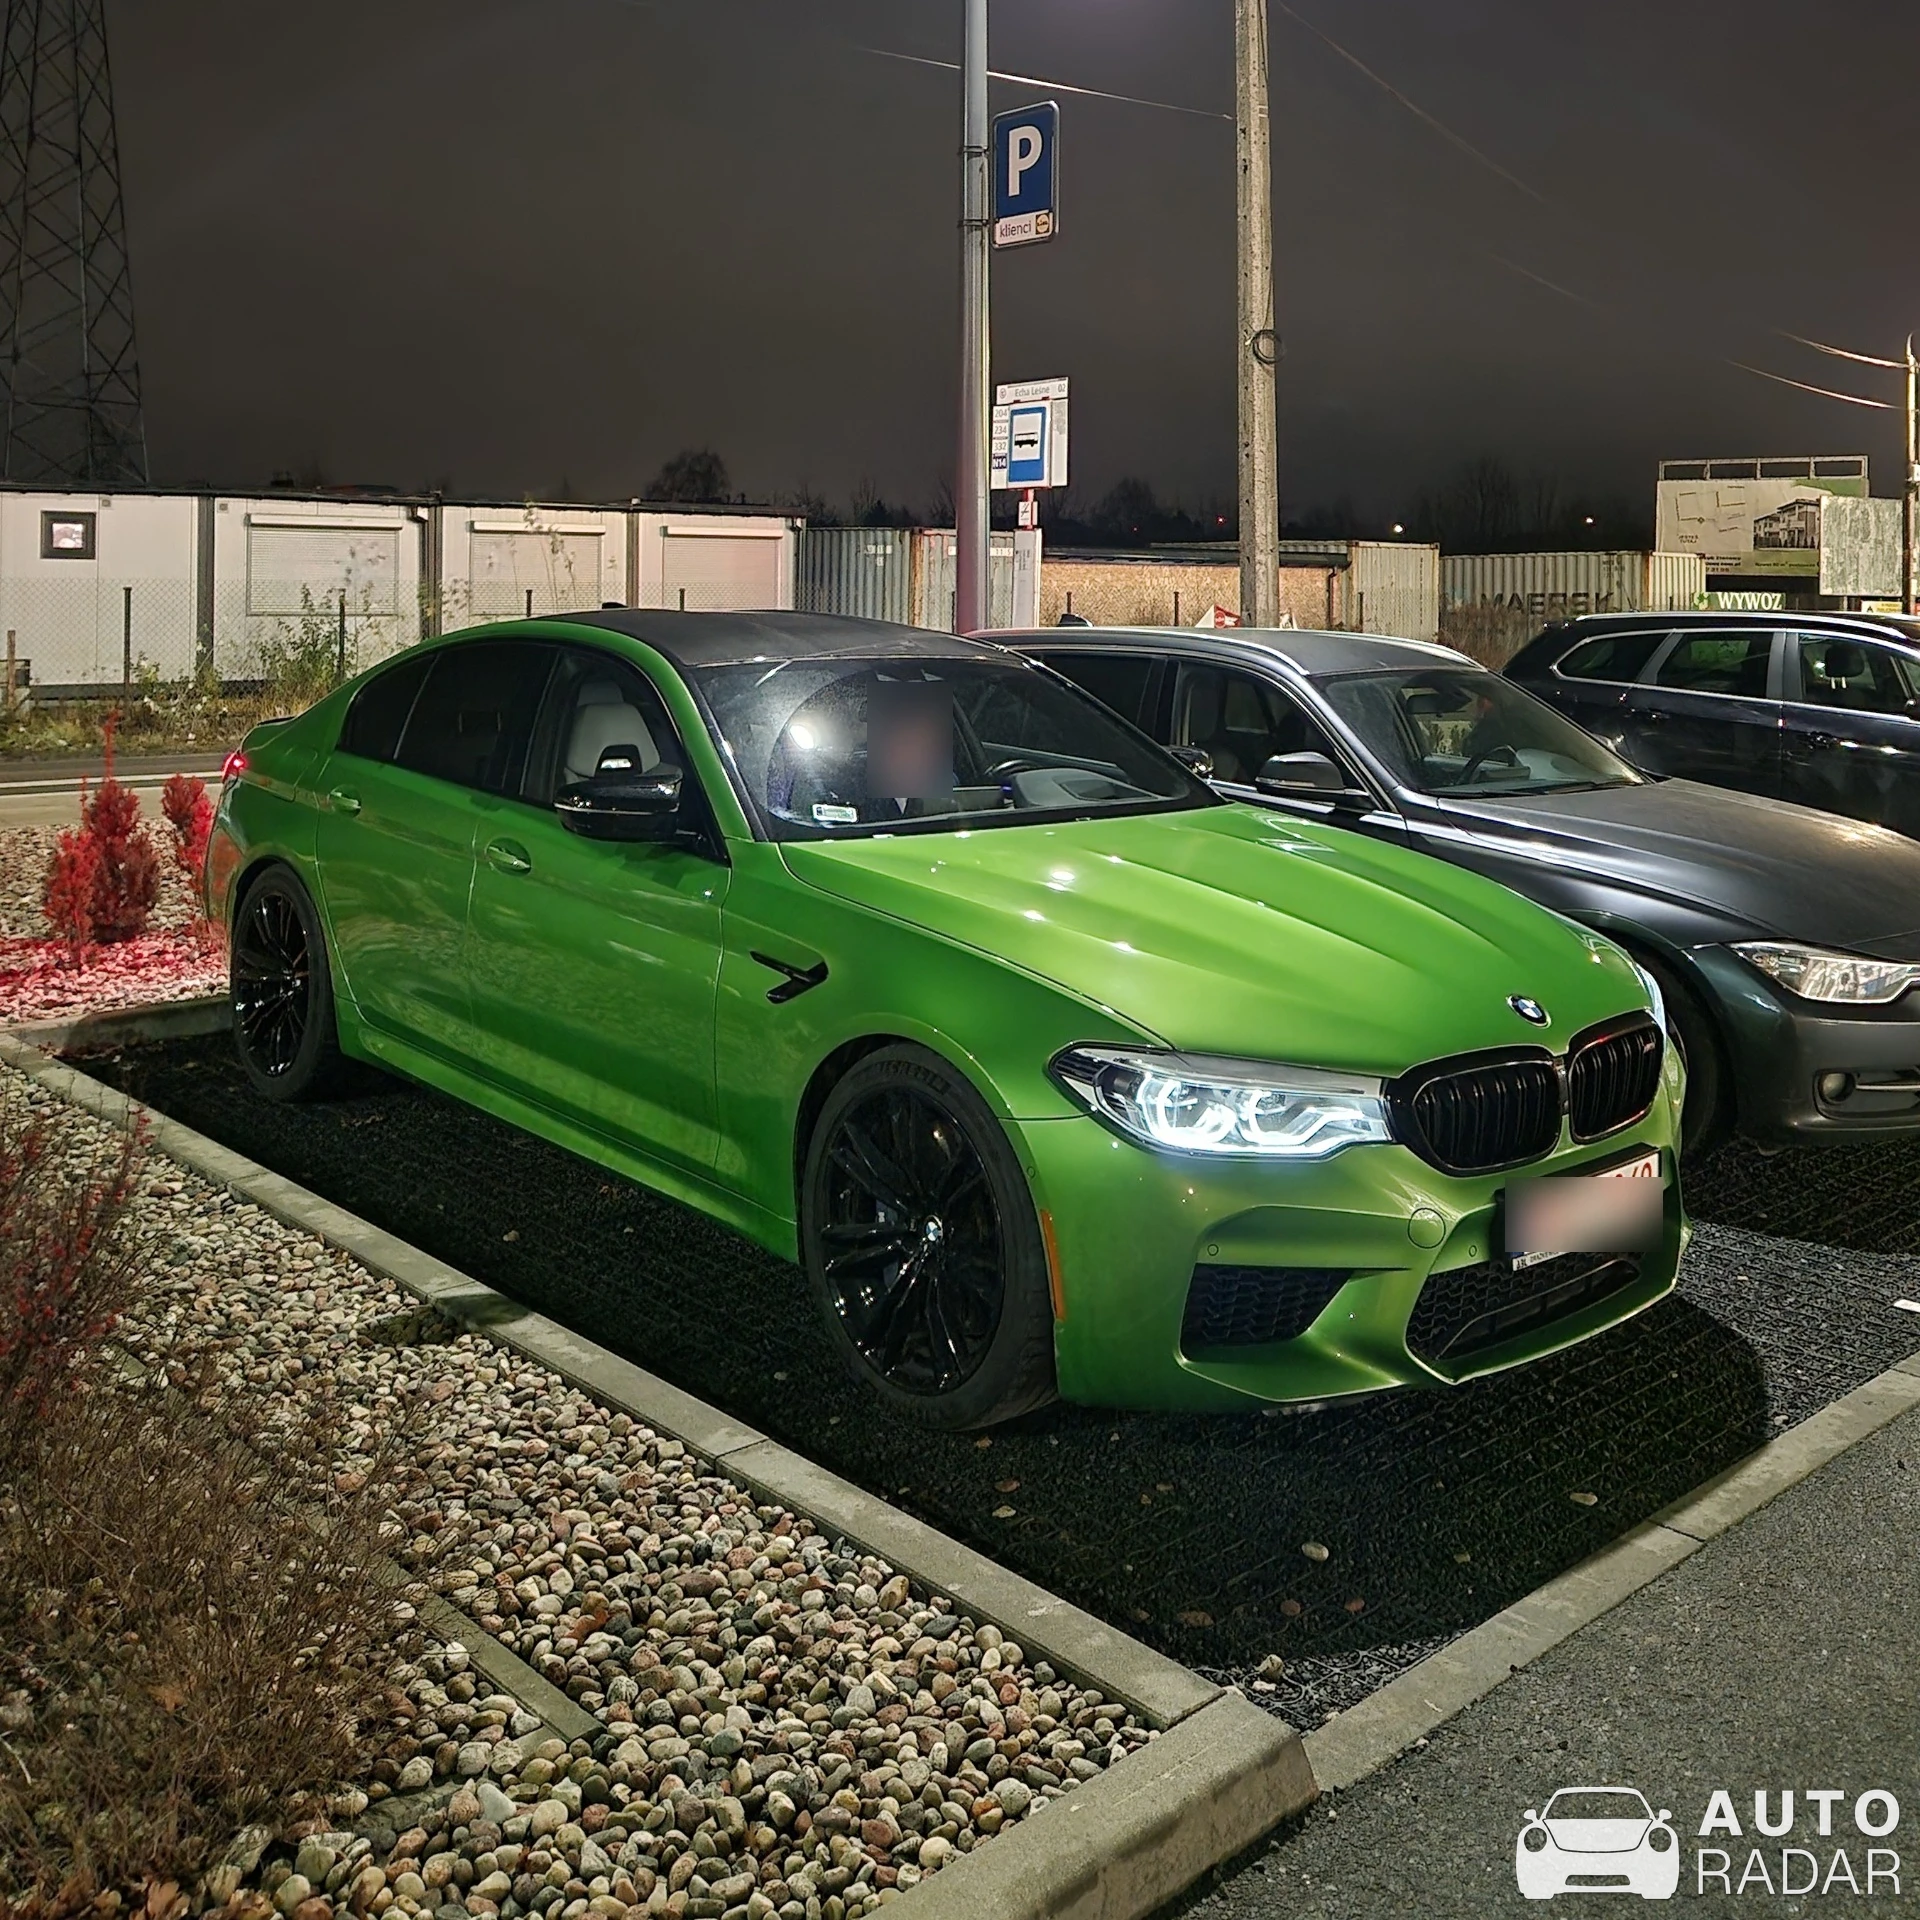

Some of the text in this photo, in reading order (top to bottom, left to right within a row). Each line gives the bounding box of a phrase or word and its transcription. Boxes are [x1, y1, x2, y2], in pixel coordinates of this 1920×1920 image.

[1008, 124, 1043, 197] P
[1000, 220, 1032, 238] klienci
[1015, 383, 1066, 397] Echa Leśne 02
[995, 409, 1007, 418] 204
[994, 425, 1007, 435] 234
[994, 441, 1007, 452] 332
[993, 458, 1007, 468] N14
[1717, 592, 1782, 610] WYWOZ
